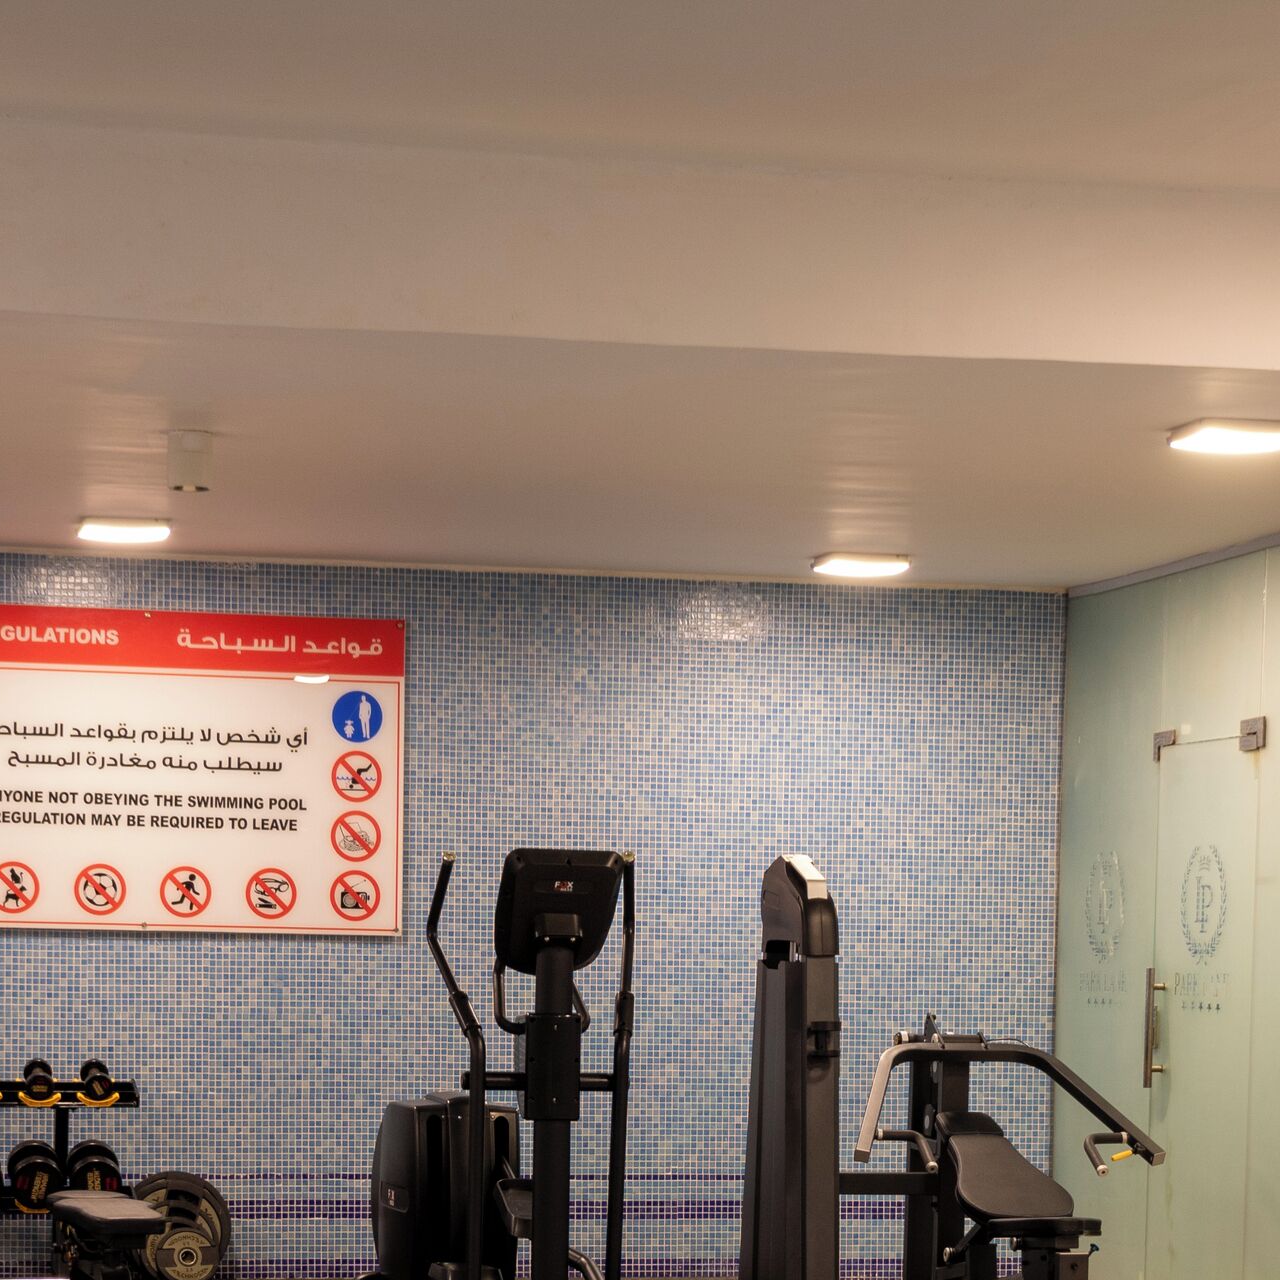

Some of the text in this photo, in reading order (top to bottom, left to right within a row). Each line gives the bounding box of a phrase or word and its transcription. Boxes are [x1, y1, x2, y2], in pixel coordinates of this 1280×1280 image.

[176, 628, 384, 659] قواعد السباحة
[70, 723, 136, 743] بقواعد
[141, 726, 194, 745] يلتزم
[199, 727, 212, 742] لا
[216, 727, 281, 746] شخص
[286, 726, 308, 753] أي
[8, 750, 283, 775] سيطلب منه مغادرة المسبح
[48, 791, 79, 804] NOT
[83, 792, 149, 806] OBEYING
[153, 794, 183, 807] THE
[187, 795, 264, 810] SWIMMING
[269, 797, 307, 811] POOL
[91, 813, 122, 827] MAY
[126, 814, 146, 827] BE
[150, 815, 224, 829] REQUIRED
[228, 817, 248, 830] TO
[252, 818, 298, 832] LEAVE
